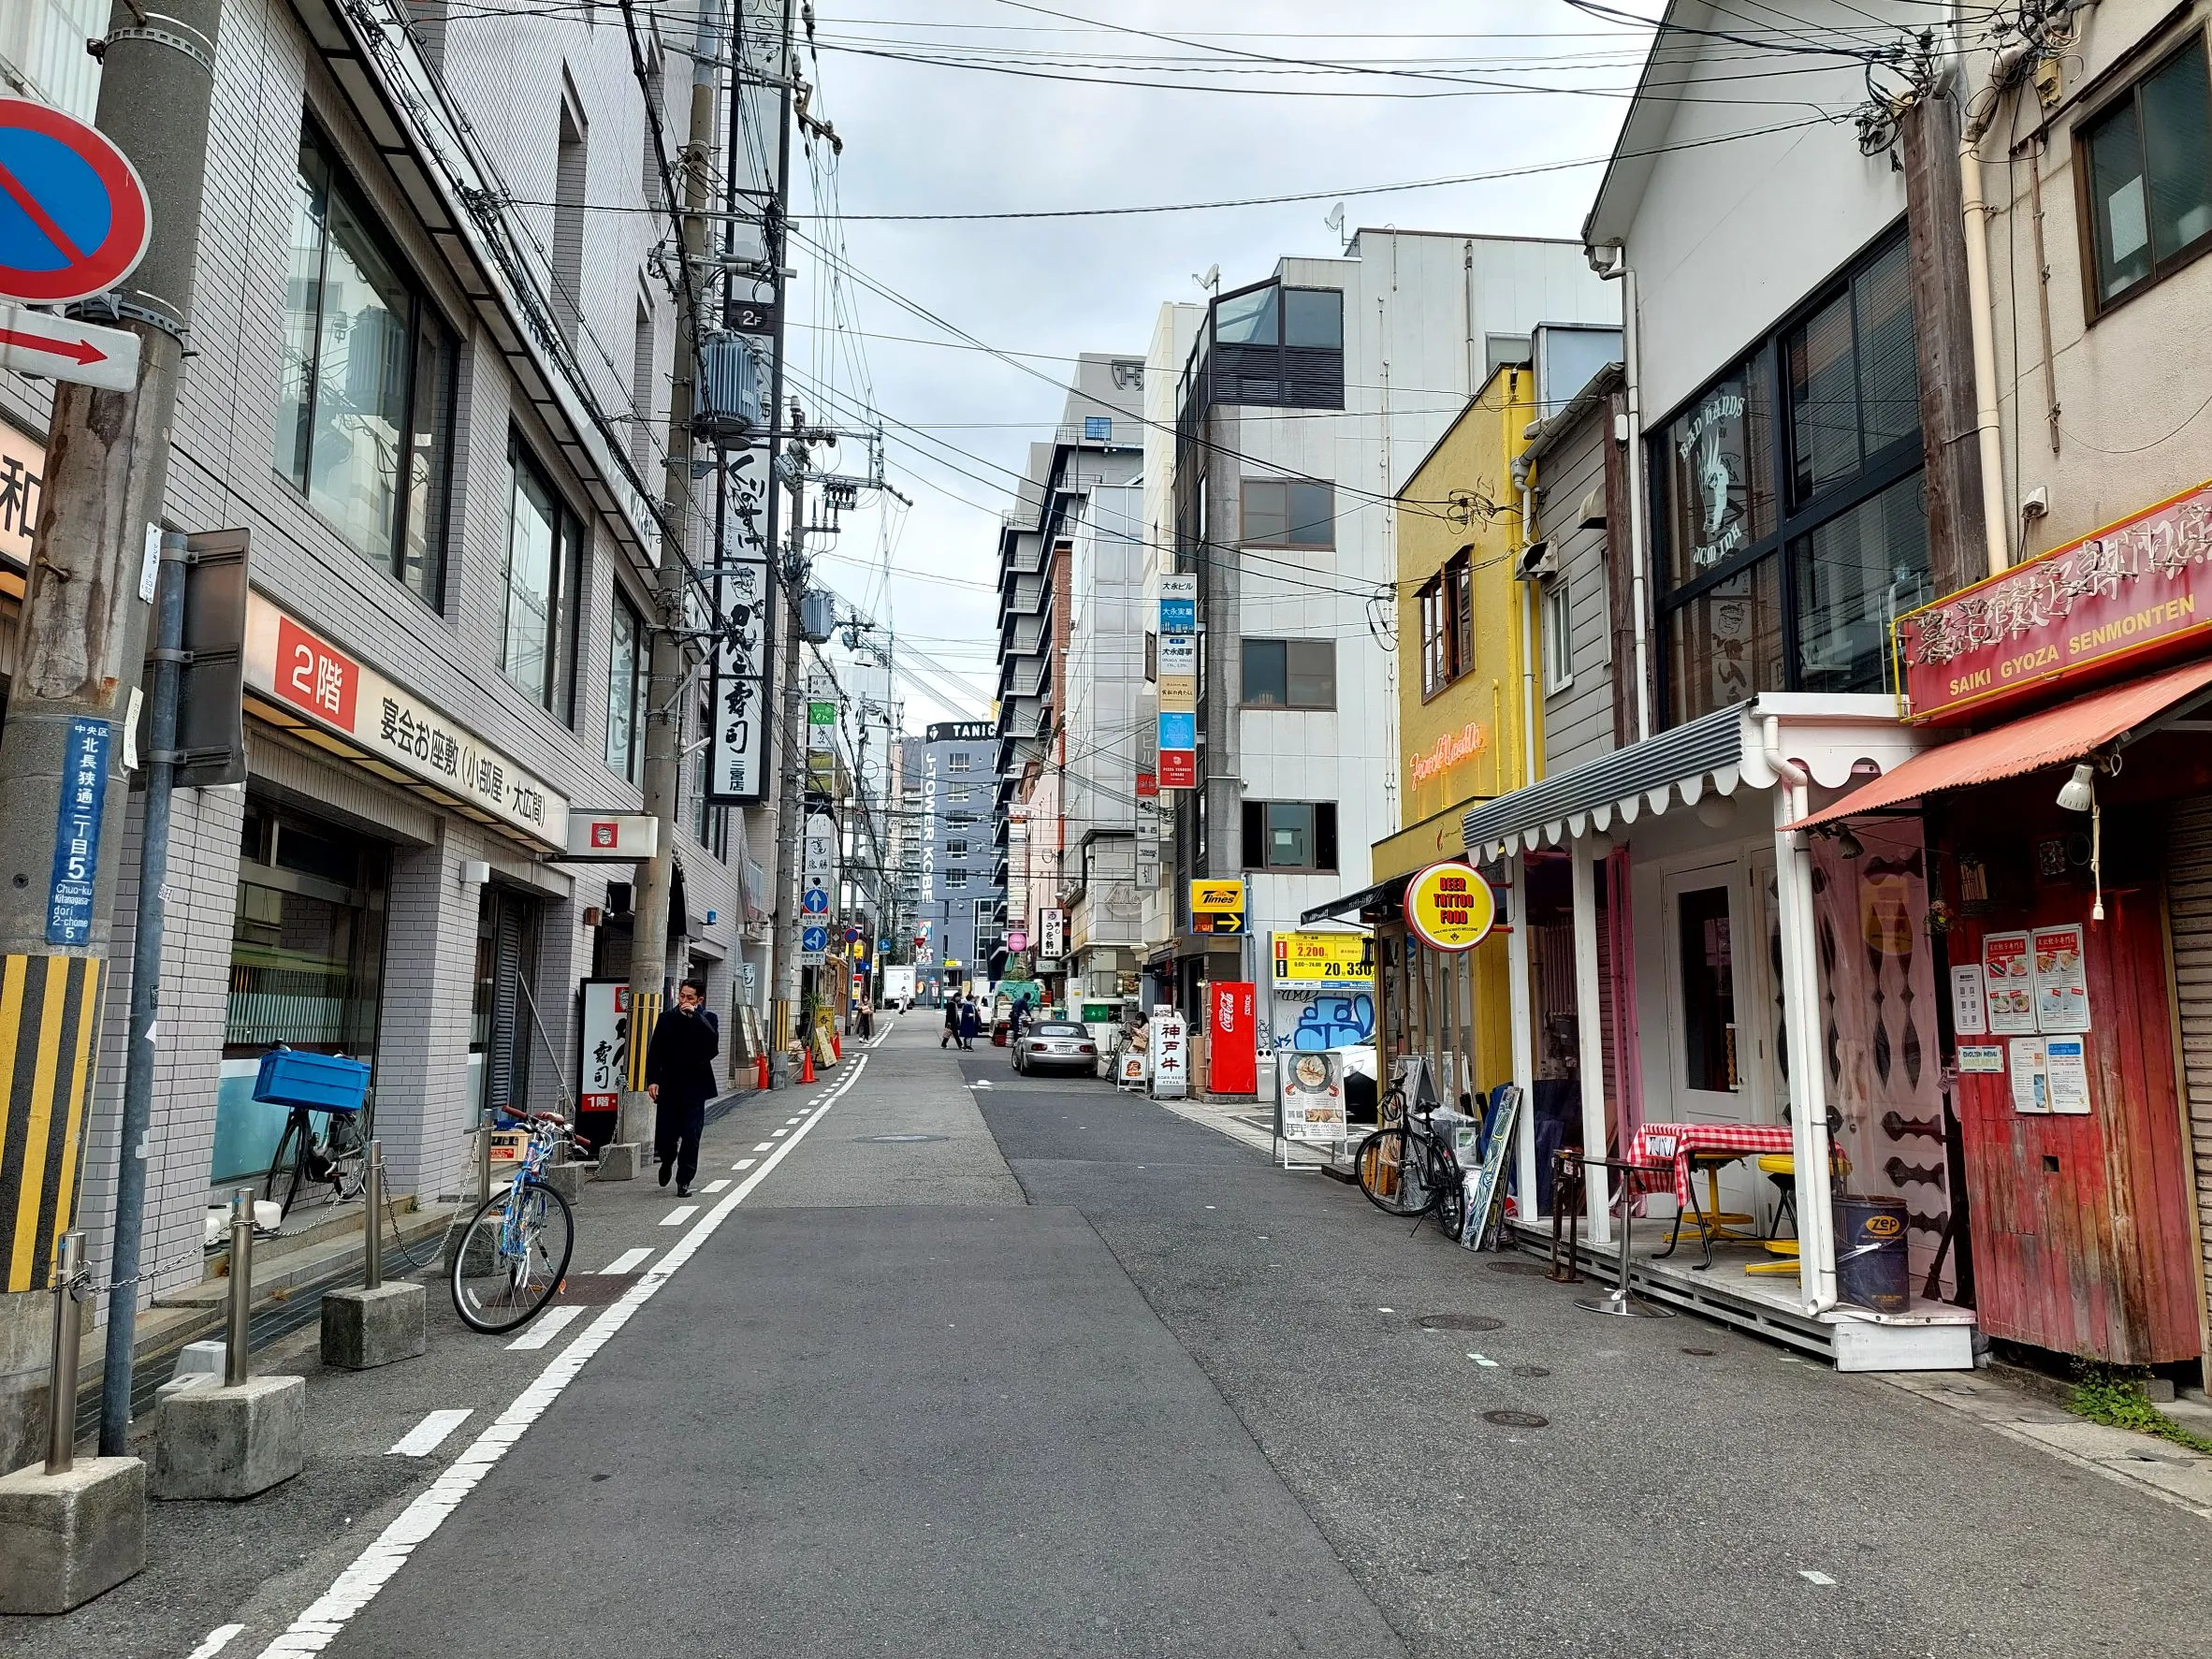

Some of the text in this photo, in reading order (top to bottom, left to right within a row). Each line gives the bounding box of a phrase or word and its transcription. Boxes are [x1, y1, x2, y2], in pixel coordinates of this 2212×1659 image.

[742, 310, 763, 326] 2F
[1679, 416, 1703, 462] BAD
[1162, 582, 1193, 590] 大永ビル
[1949, 594, 2195, 696] SAIKI GYOZA SENMONTEN
[291, 643, 343, 715] 2階
[75, 725, 109, 736] 中央区
[730, 760, 745, 791] 三宮店
[922, 752, 937, 904] J-TOWER KOBE
[56, 883, 92, 895] Chuo-ku
[1439, 877, 1466, 892] BEER
[54, 894, 91, 906] Kitanagasa-
[1202, 891, 1237, 904] Times
[1433, 894, 1475, 908] TATTOO
[54, 906, 73, 915] dori
[1440, 910, 1468, 924] FOOD
[52, 916, 88, 927] 2-chome
[65, 927, 74, 939] 5
[1220, 991, 1233, 1032] Coca-Cola
[1160, 1024, 1180, 1072] 神戸牛
[588, 1096, 609, 1108] 1階
